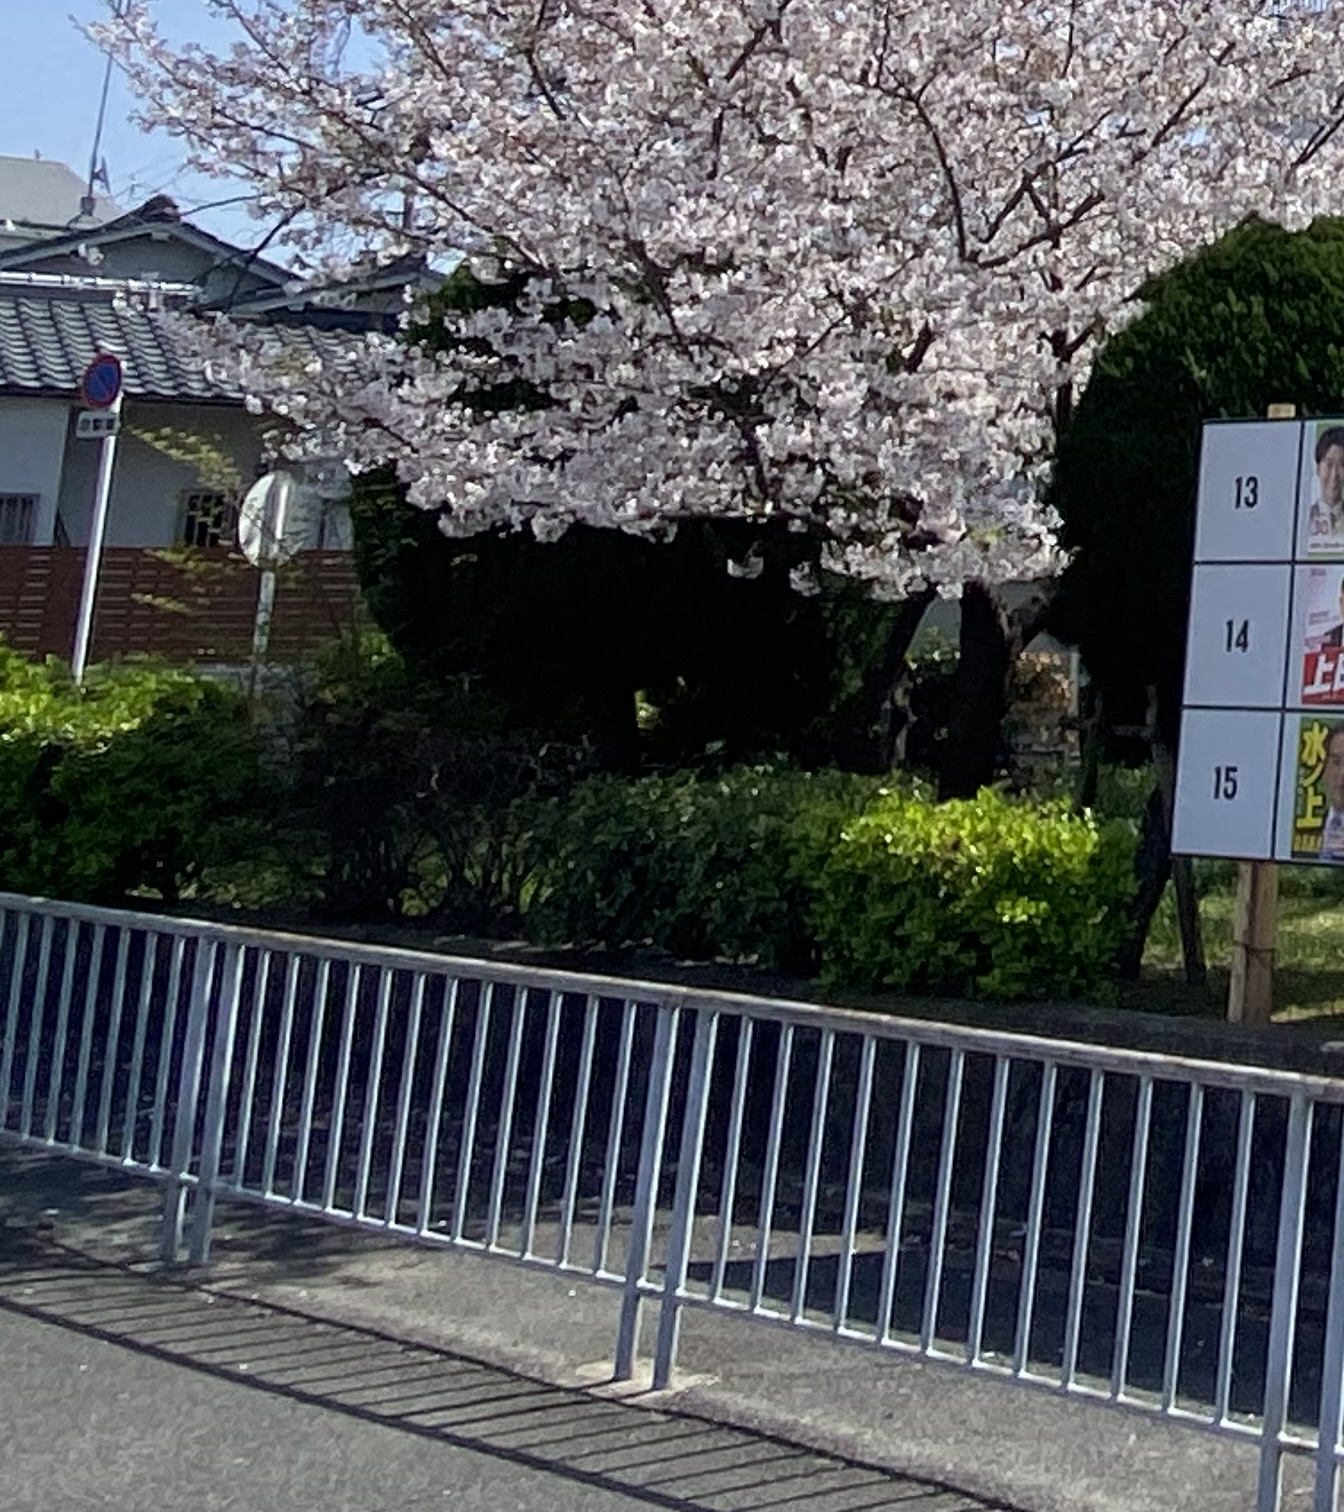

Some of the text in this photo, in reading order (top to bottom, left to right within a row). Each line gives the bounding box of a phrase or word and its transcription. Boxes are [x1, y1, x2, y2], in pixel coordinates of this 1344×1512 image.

[1233, 476, 1258, 509] 13
[1226, 620, 1250, 652] 14
[1213, 766, 1238, 800] 15
[1296, 721, 1328, 829] 水ノ上
